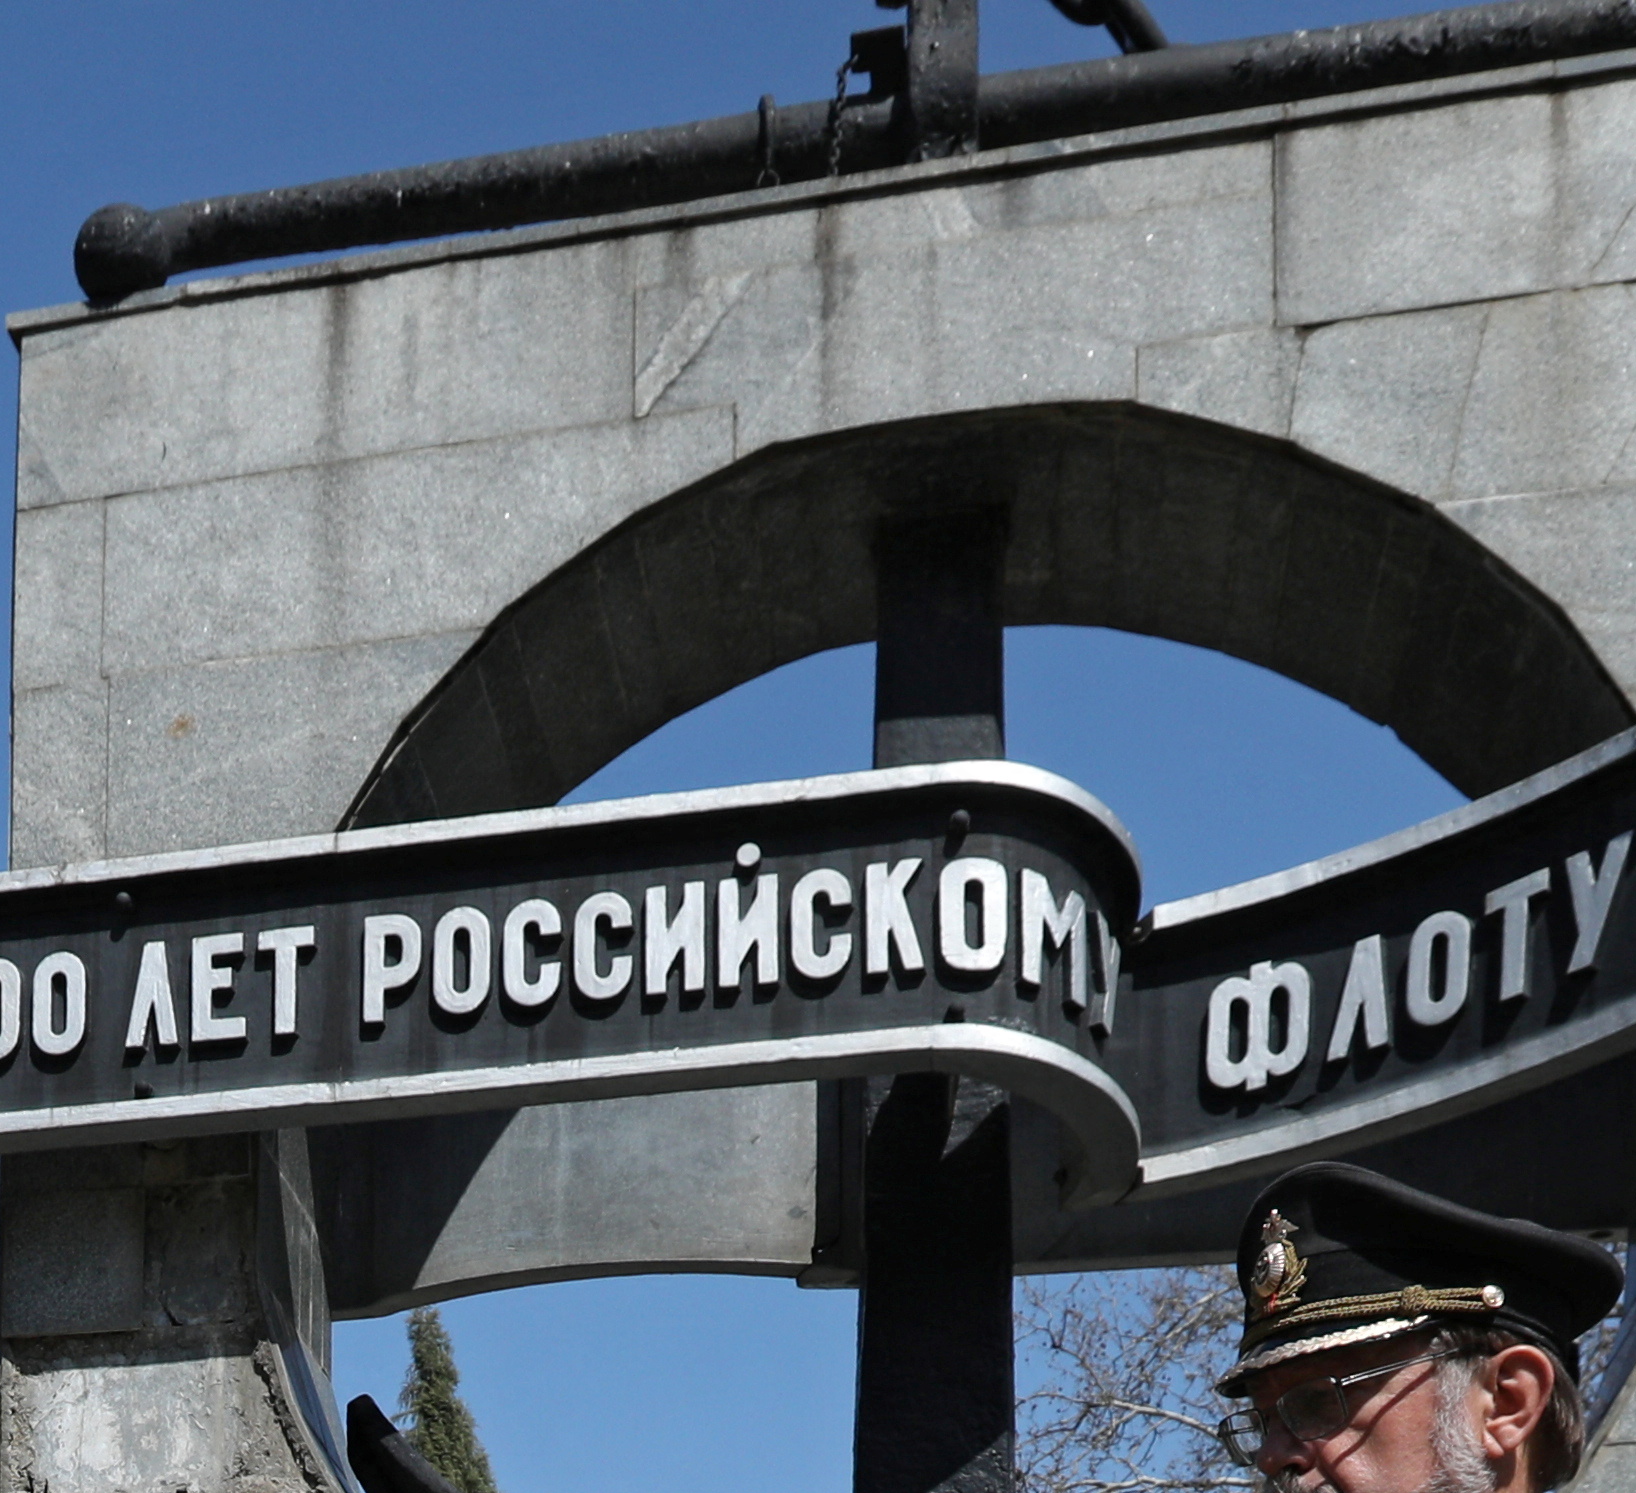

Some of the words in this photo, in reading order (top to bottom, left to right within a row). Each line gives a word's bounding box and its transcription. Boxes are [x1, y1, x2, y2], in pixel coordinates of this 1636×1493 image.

[124, 925, 316, 1049] ЛЕТ
[362, 842, 1122, 1035] РОССИЙСКОМУ
[1206, 831, 1635, 1092] ФЛОТУ
